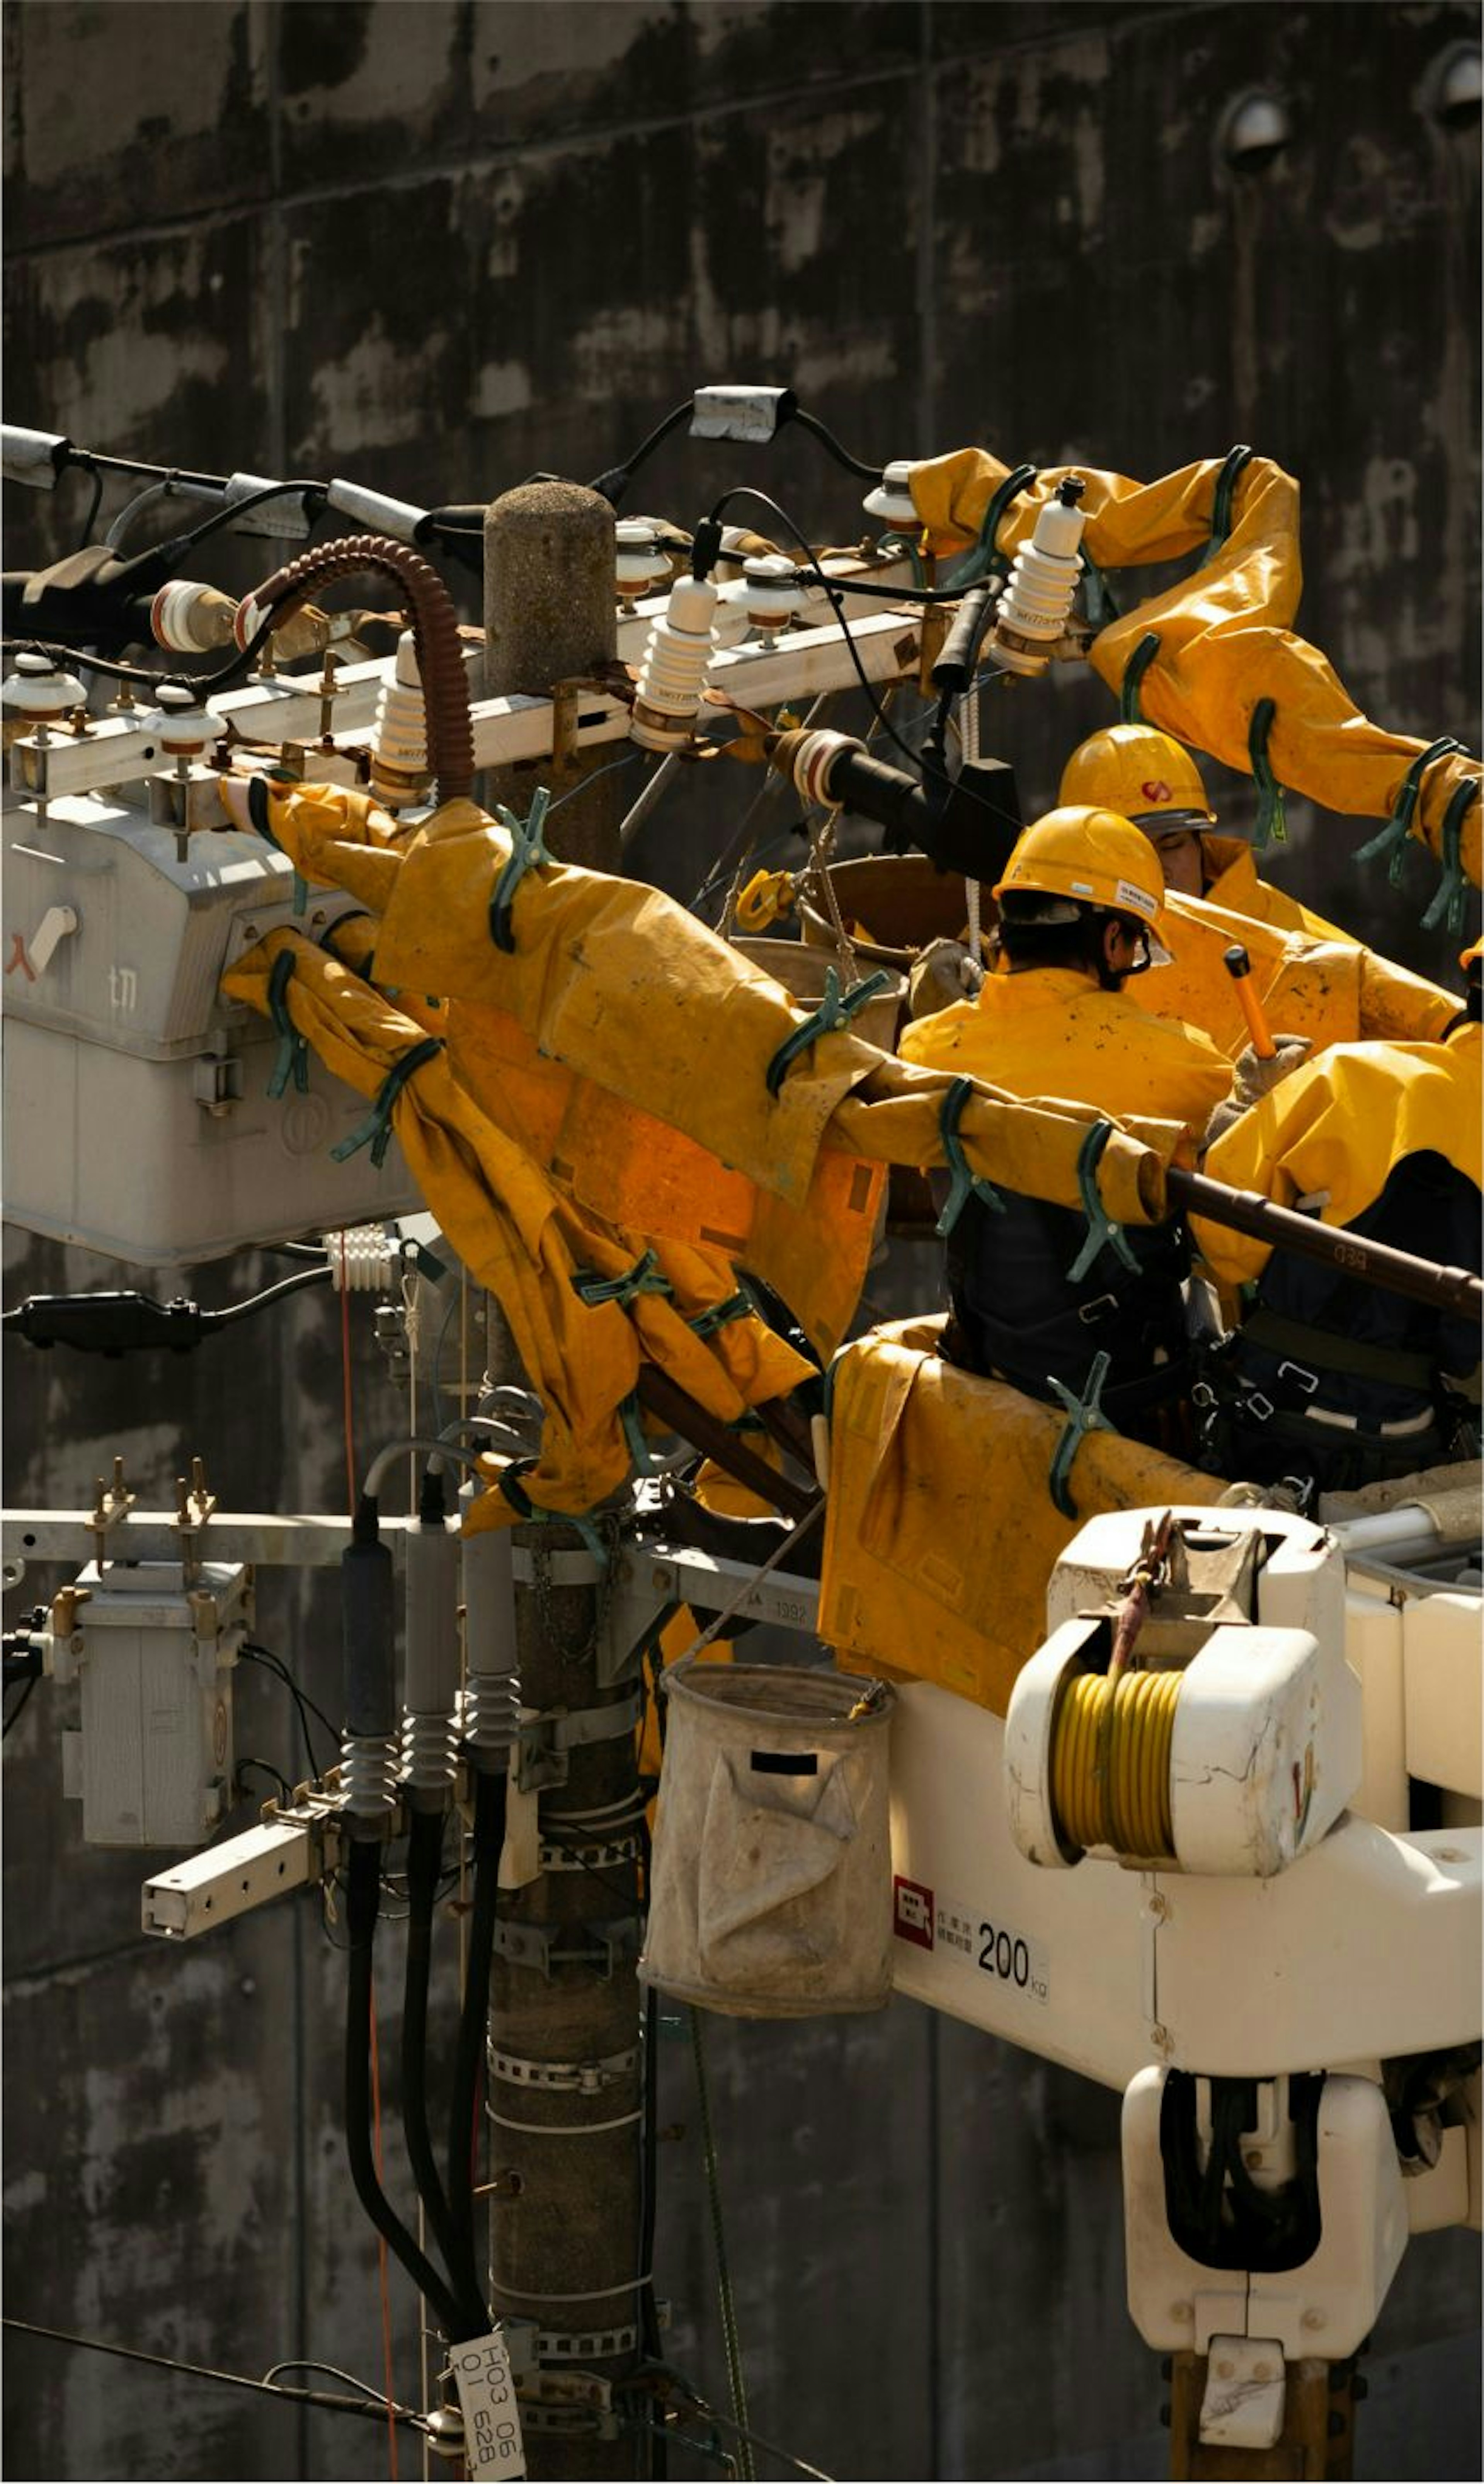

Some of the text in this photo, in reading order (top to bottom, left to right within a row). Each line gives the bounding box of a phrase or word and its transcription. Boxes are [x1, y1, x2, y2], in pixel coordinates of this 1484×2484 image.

[979, 1923, 1028, 1987] 200
[482, 2345, 516, 2458] H03 06
[474, 2410, 495, 2464] 628
